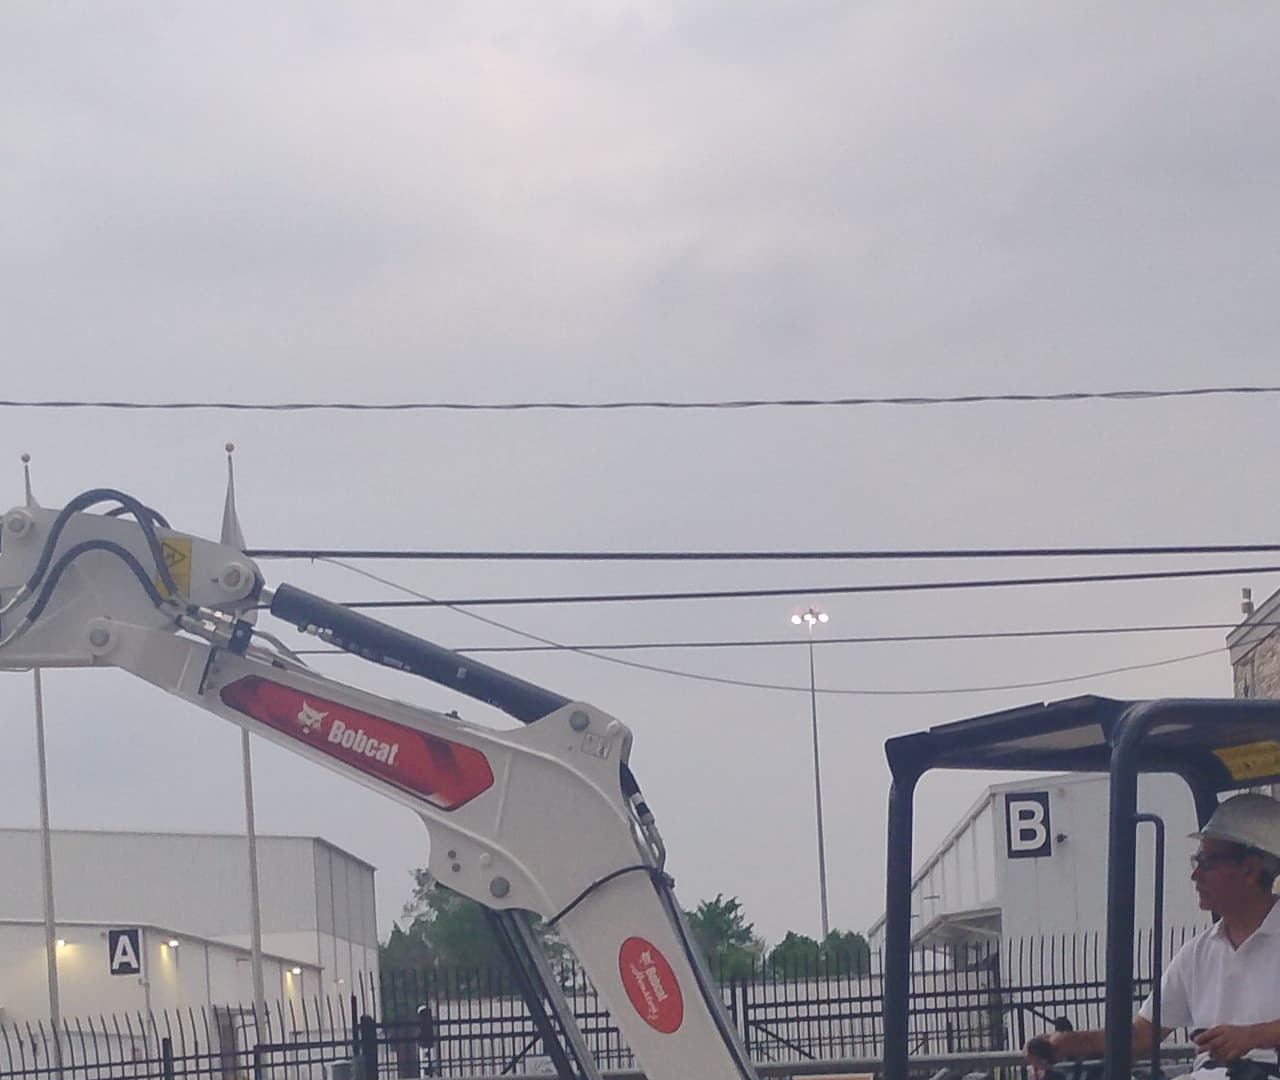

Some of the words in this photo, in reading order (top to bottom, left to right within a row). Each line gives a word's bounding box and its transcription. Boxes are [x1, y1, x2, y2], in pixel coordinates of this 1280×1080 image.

[327, 719, 400, 766] Bobcat
[1009, 800, 1047, 851] B
[112, 935, 139, 969] A
